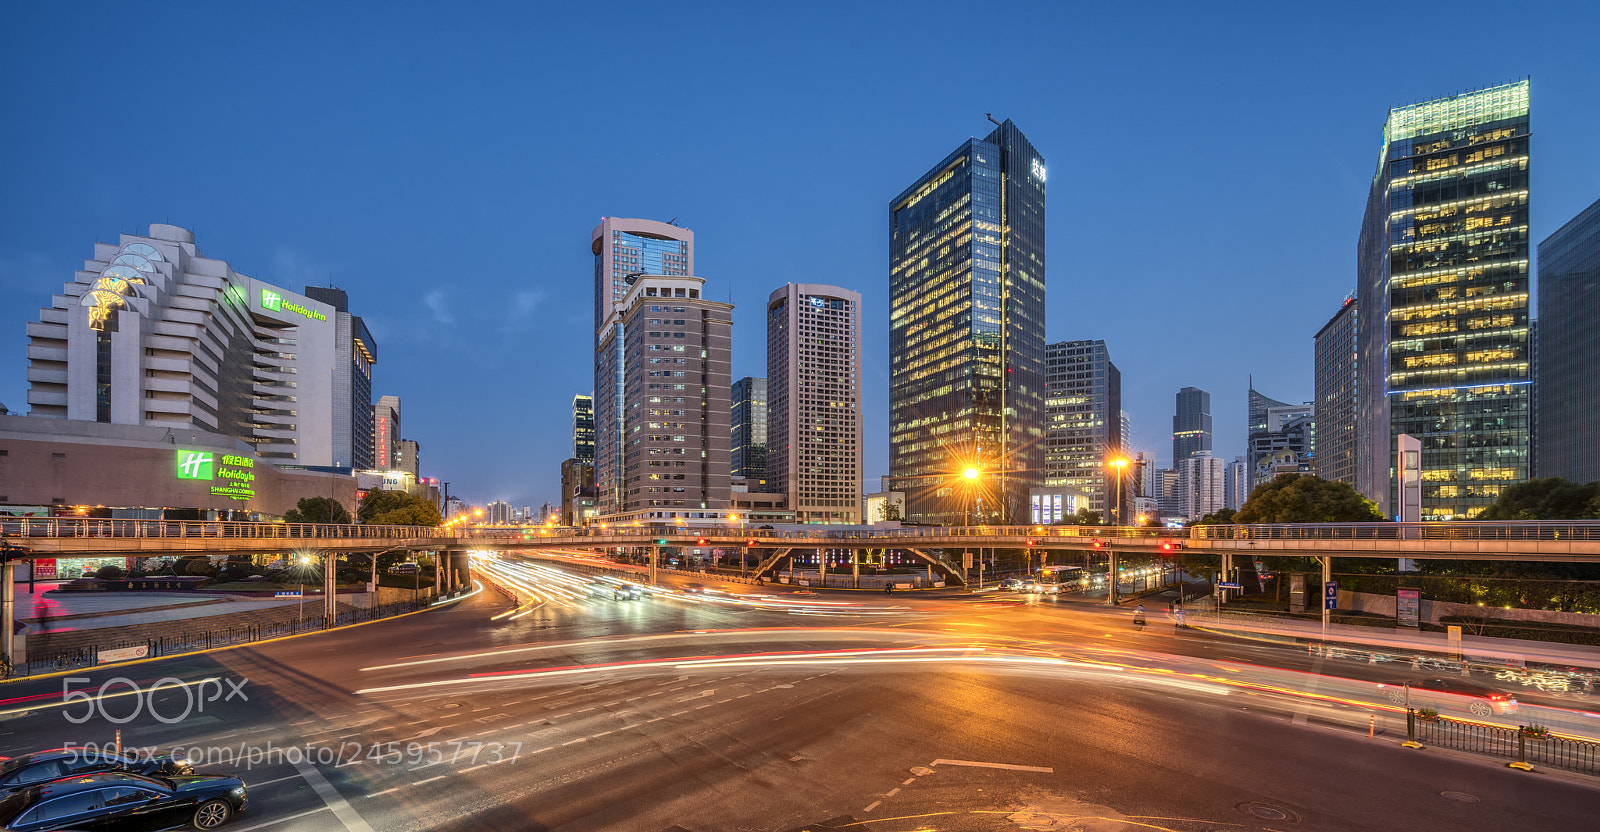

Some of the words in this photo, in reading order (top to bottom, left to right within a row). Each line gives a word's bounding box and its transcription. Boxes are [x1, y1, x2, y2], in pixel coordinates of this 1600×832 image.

[281, 299, 313, 319] Holiday
[313, 309, 326, 322] Inn
[217, 467, 249, 482] Holiday
[210, 486, 239, 494] SHANGHAI
